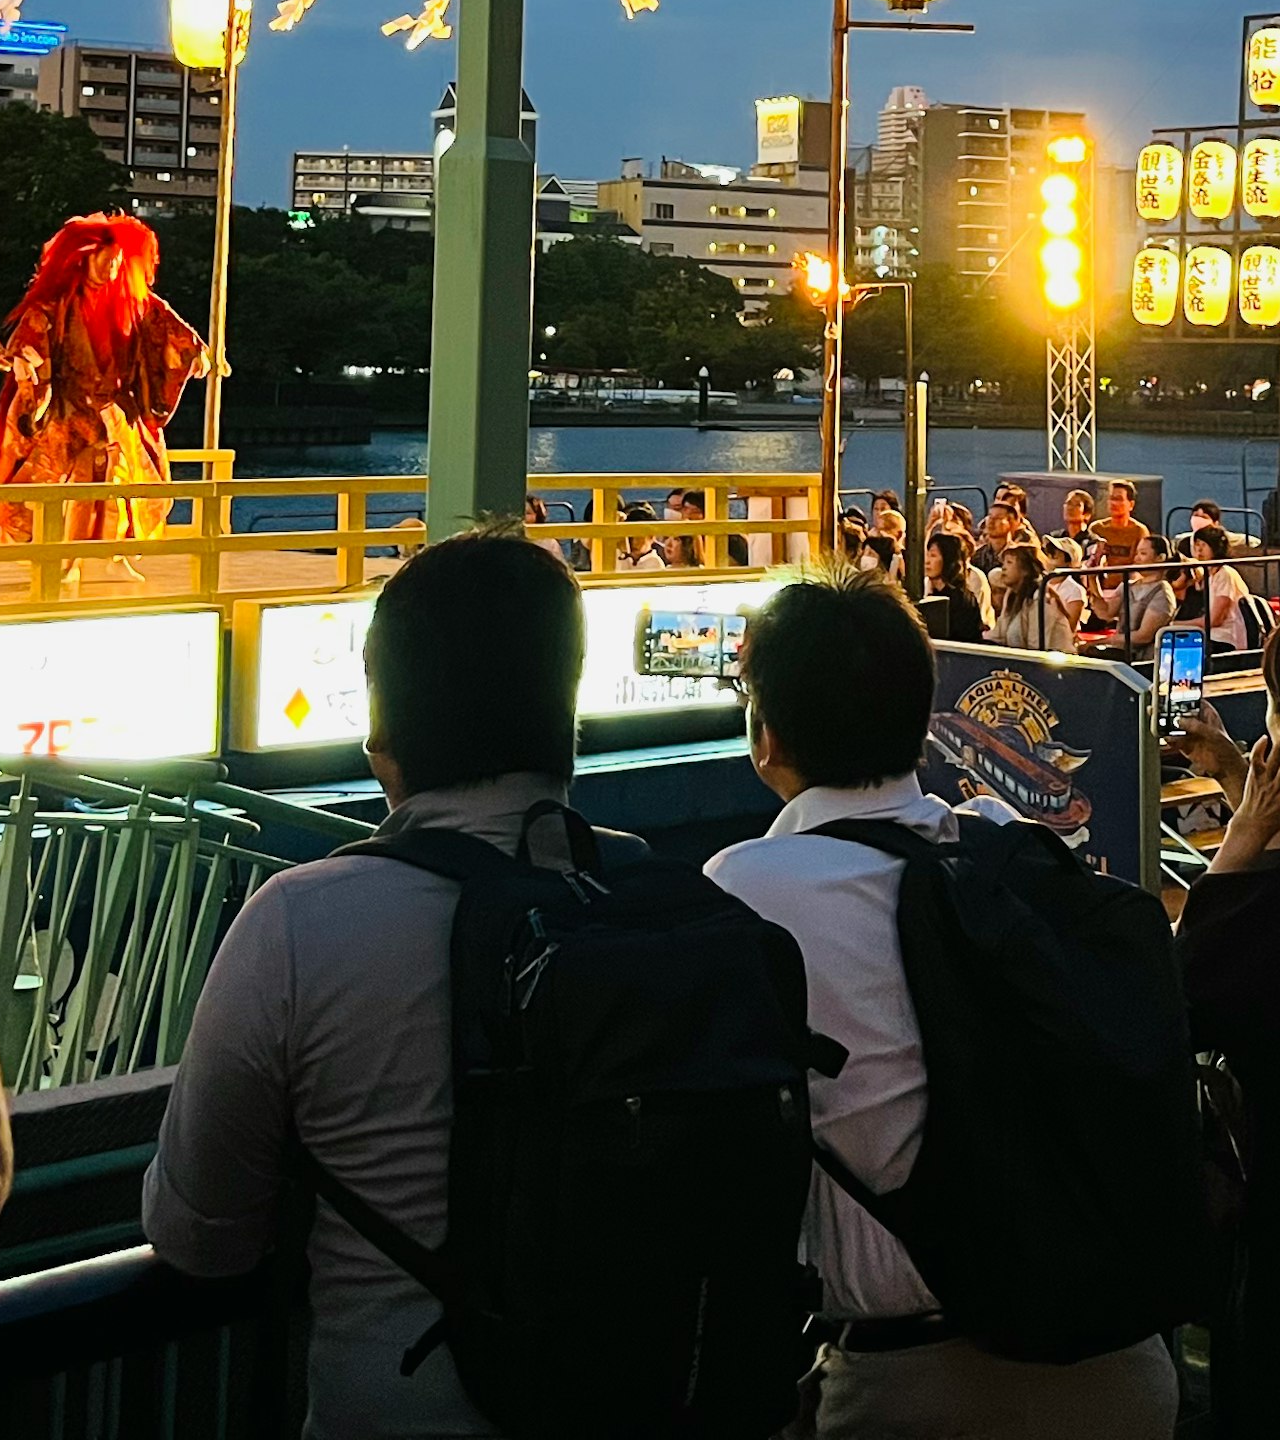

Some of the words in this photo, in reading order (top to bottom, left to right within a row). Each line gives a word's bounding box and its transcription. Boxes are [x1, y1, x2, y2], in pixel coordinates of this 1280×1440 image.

[1250, 36, 1278, 92] 能船
[1140, 151, 1162, 209] 観世流
[1246, 148, 1270, 205] 宝生流
[1243, 254, 1263, 311] 観世流
[967, 681, 1004, 705] AQUA
[1011, 682, 1056, 724] LINER
